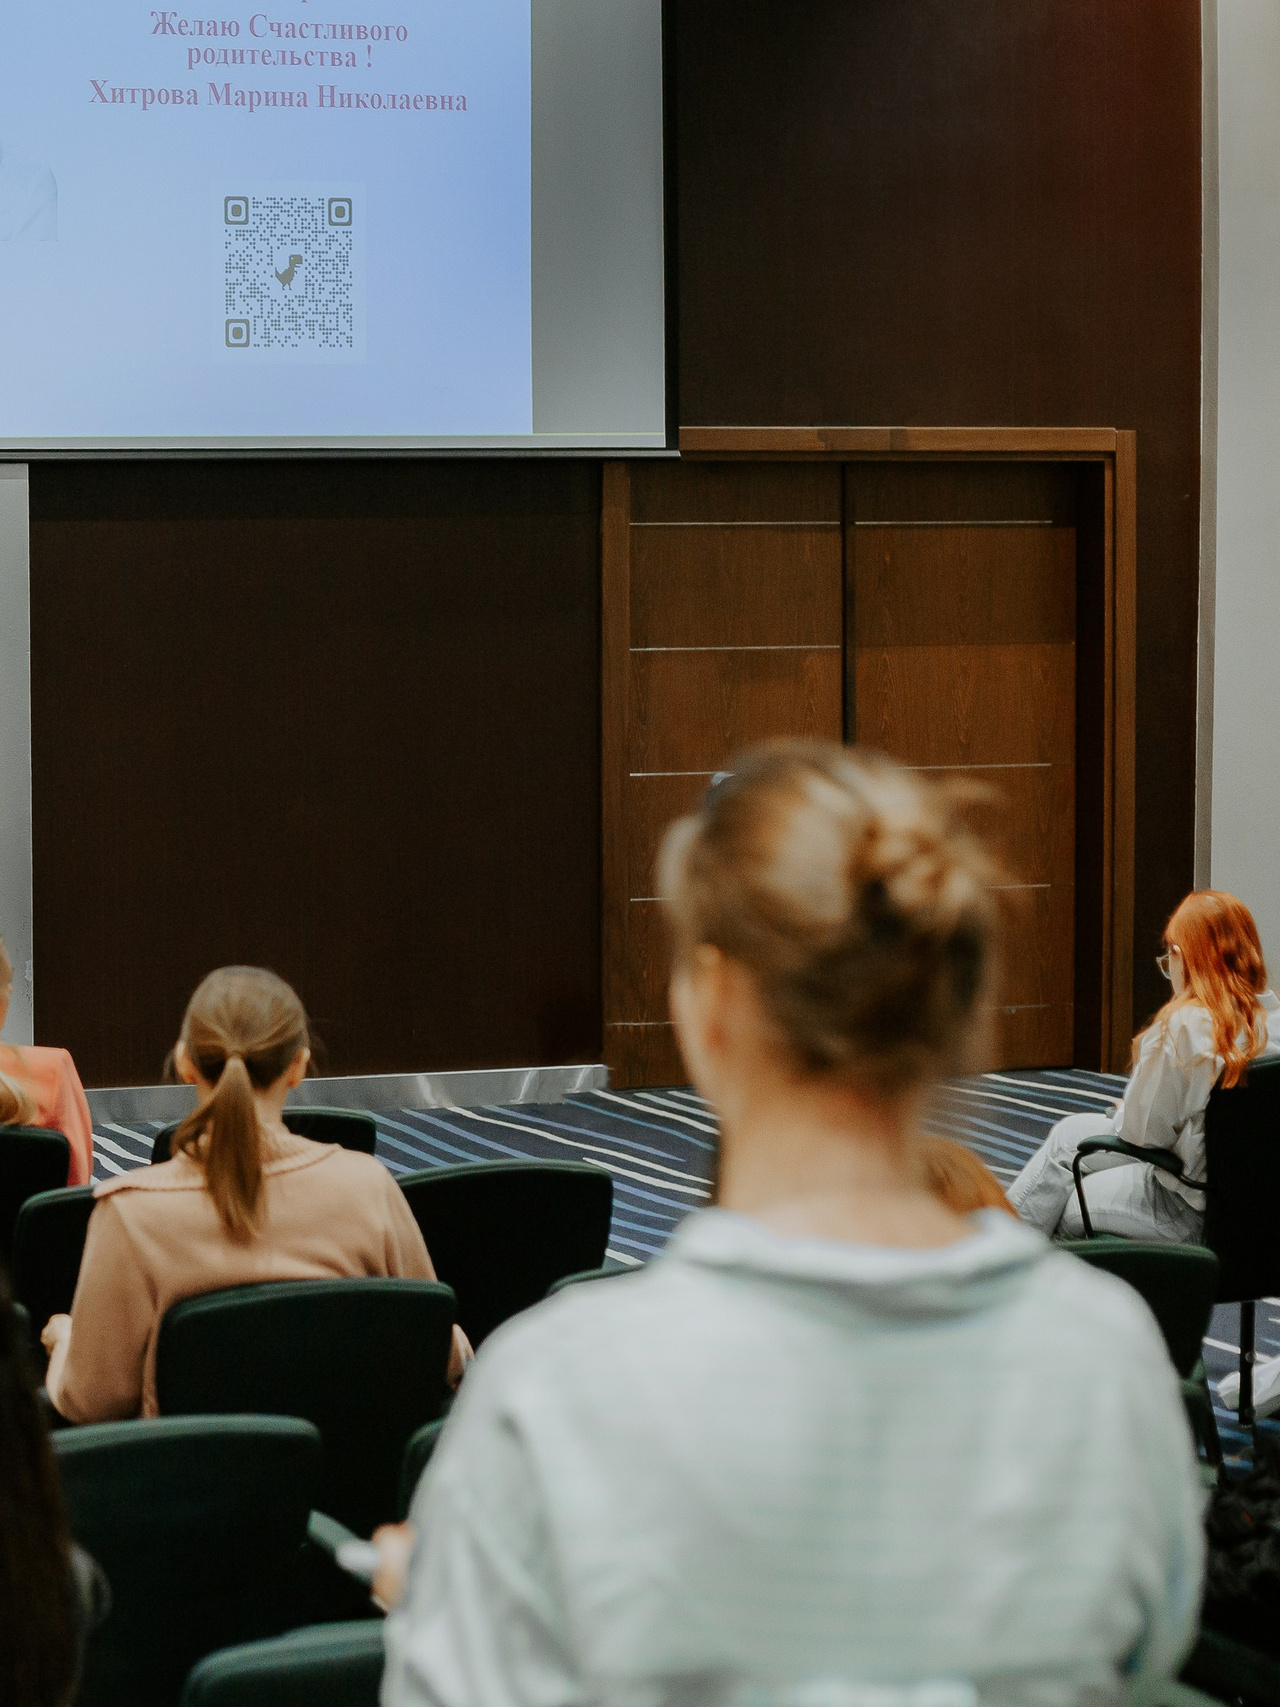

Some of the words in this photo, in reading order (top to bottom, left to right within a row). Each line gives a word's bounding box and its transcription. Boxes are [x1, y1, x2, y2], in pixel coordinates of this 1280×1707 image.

[150, 10, 240, 38] Желаю
[249, 13, 408, 42] Счастливого
[186, 46, 357, 70] родительства
[366, 44, 372, 68] !
[88, 79, 199, 111] Хитрова
[207, 82, 309, 114] Марина
[318, 84, 468, 112] Николаевна
